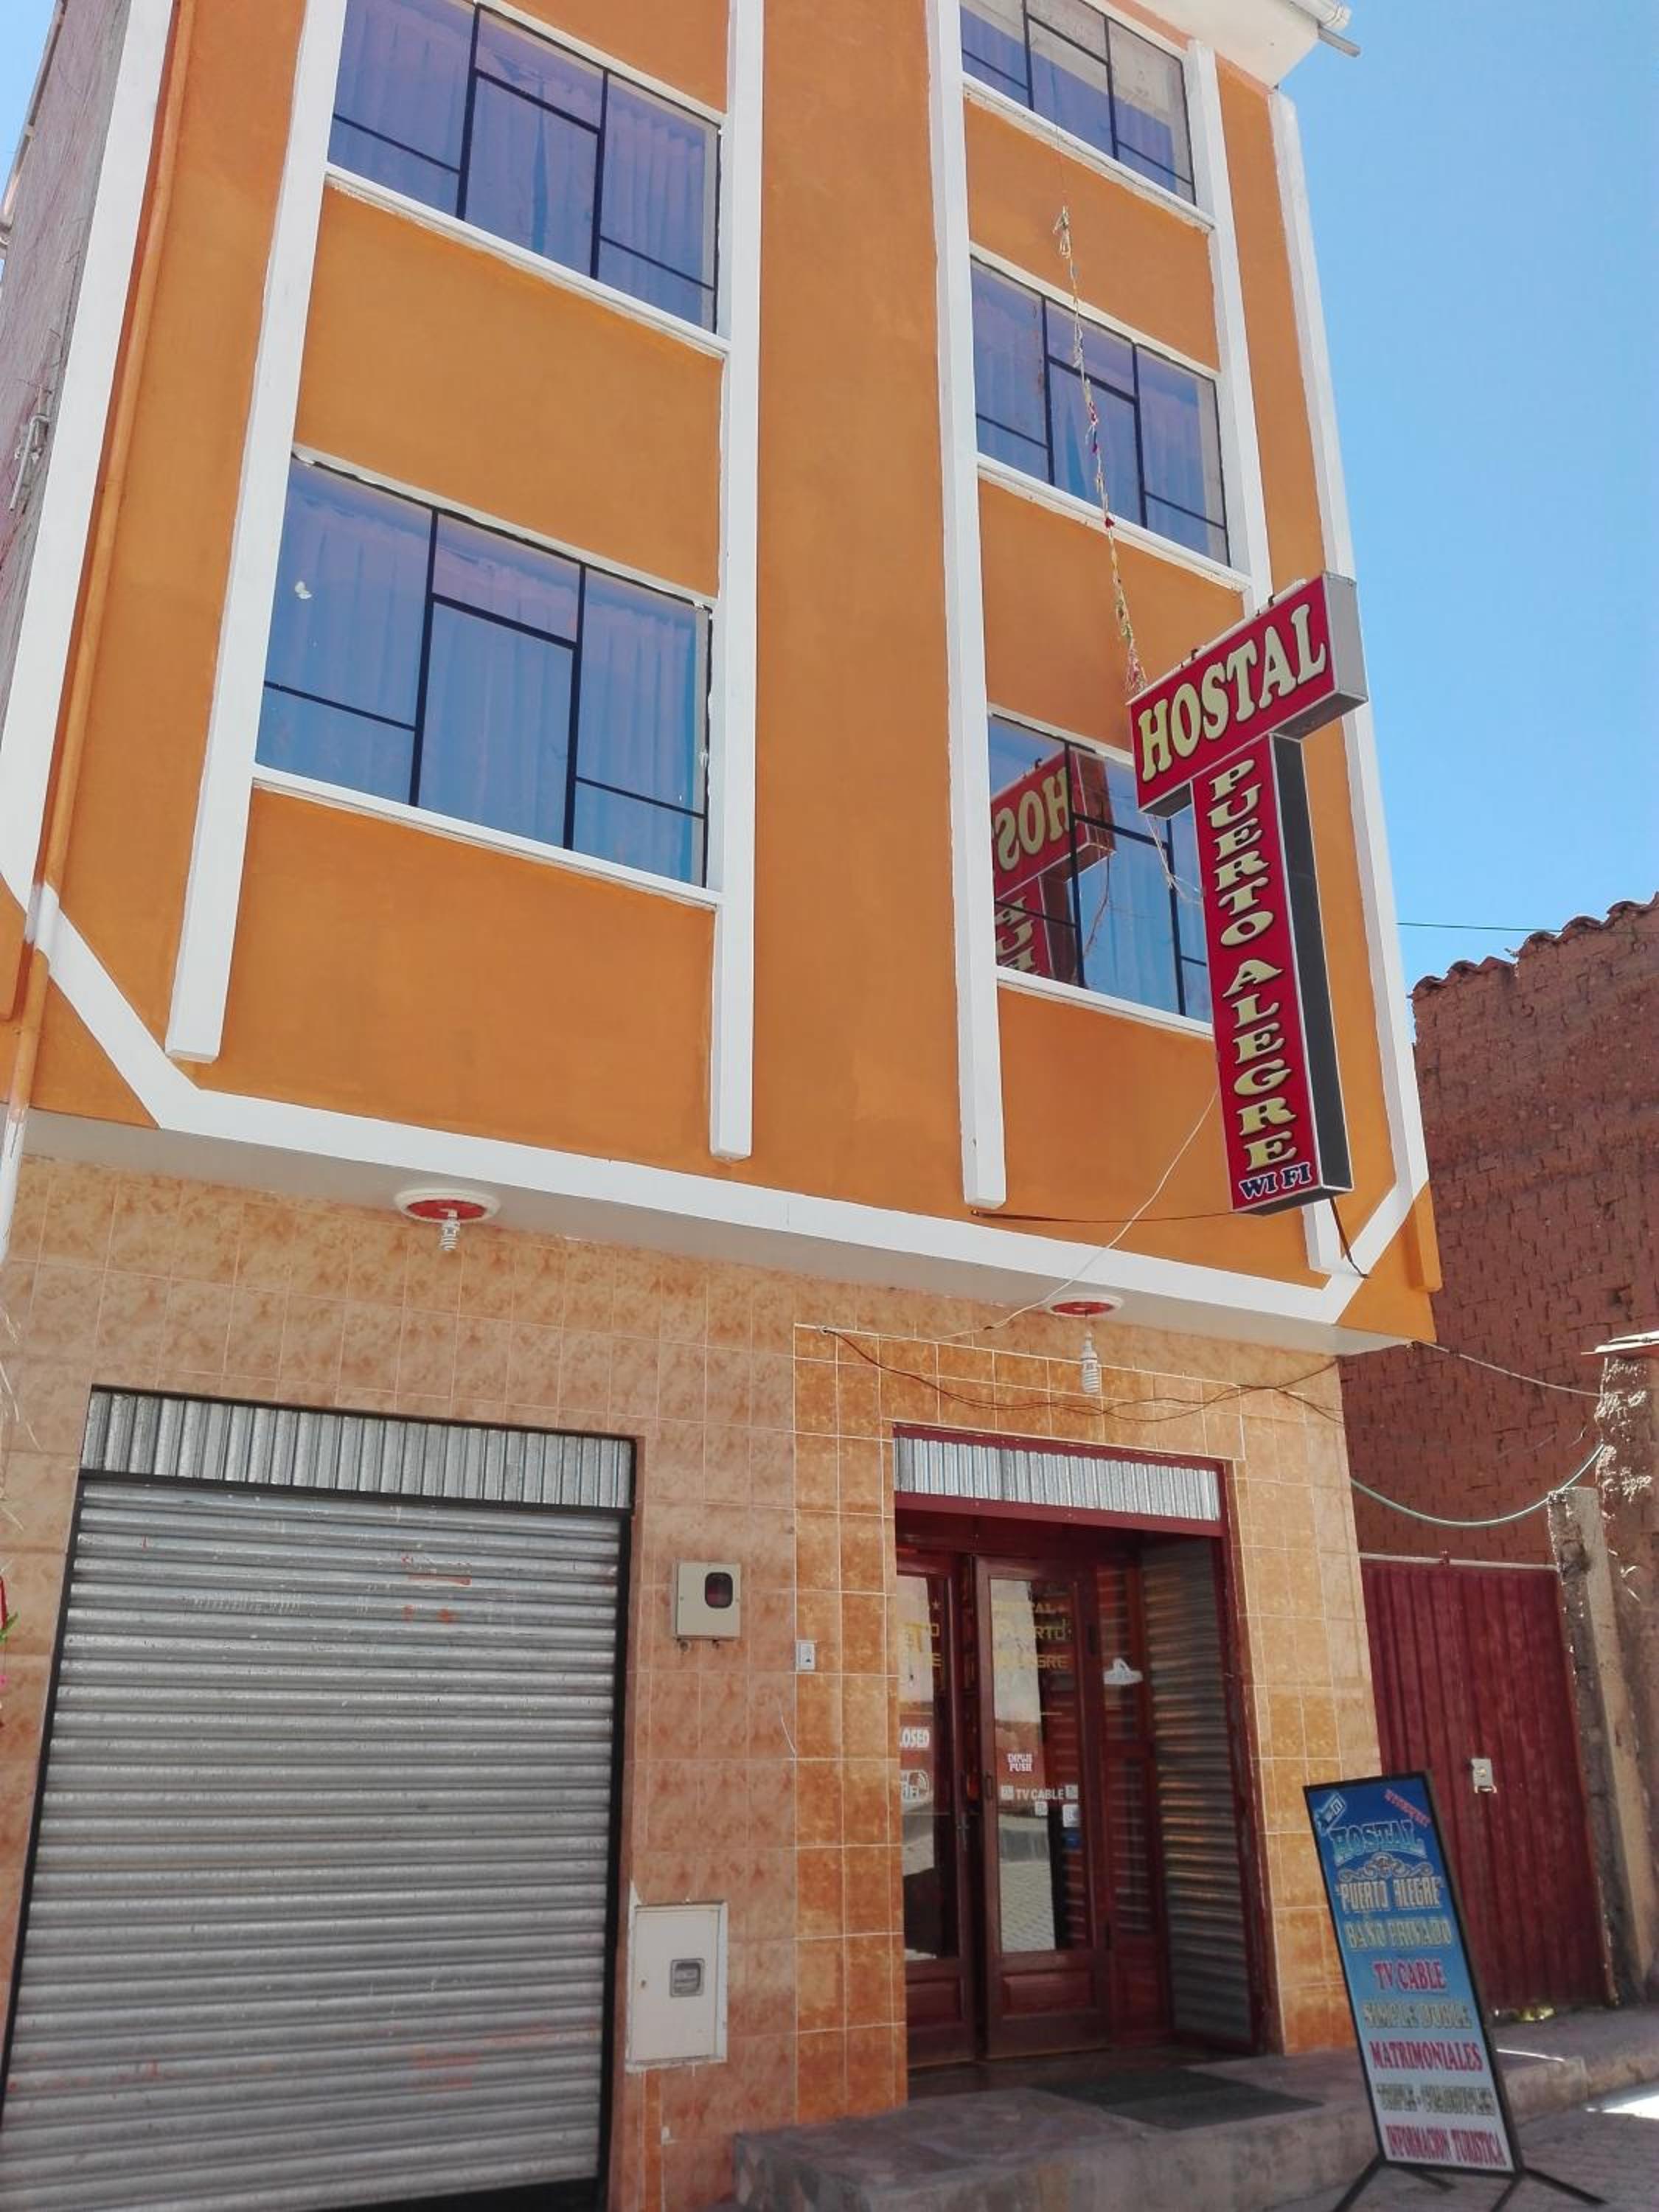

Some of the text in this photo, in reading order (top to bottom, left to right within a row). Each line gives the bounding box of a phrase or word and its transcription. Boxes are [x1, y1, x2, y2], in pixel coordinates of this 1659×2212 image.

[1138, 603, 1326, 784] HOSTAL
[1207, 758, 1298, 1172] PUERTO ALEGRE
[1239, 1161, 1313, 1200] WI FI
[1009, 1762, 1033, 1772] PUSH
[1015, 1789, 1065, 1800] TV CABLE
[1329, 1819, 1428, 1868] HOSTAL
[1372, 1959, 1447, 1992] TV CABLE
[1369, 2040, 1484, 2072] MATRIMONIALES
